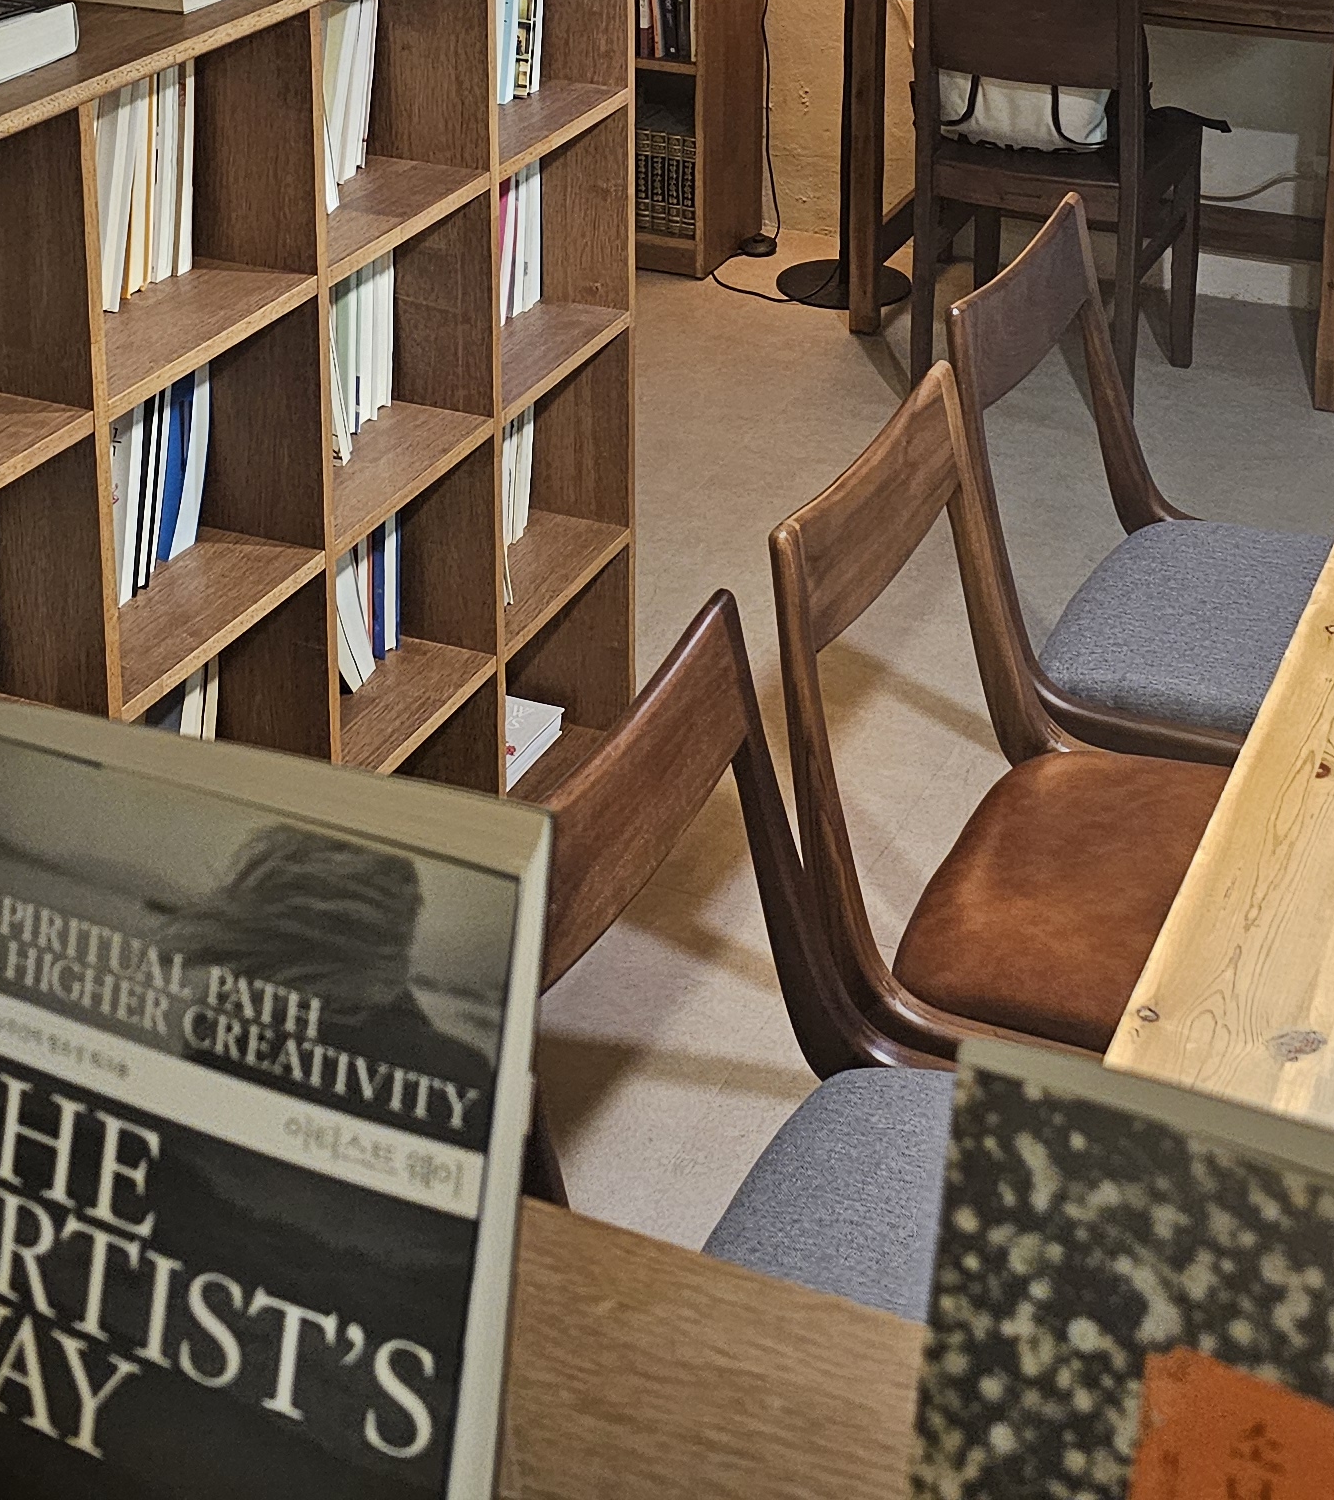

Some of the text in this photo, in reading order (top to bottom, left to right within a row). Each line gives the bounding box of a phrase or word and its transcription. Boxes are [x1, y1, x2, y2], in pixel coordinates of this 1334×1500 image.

[5, 938, 168, 1035] HIGHER
[182, 1005, 481, 1132] CREATIVITY
[206, 965, 322, 1041] PATH
[283, 1112, 466, 1200] 아티스트 웨이
